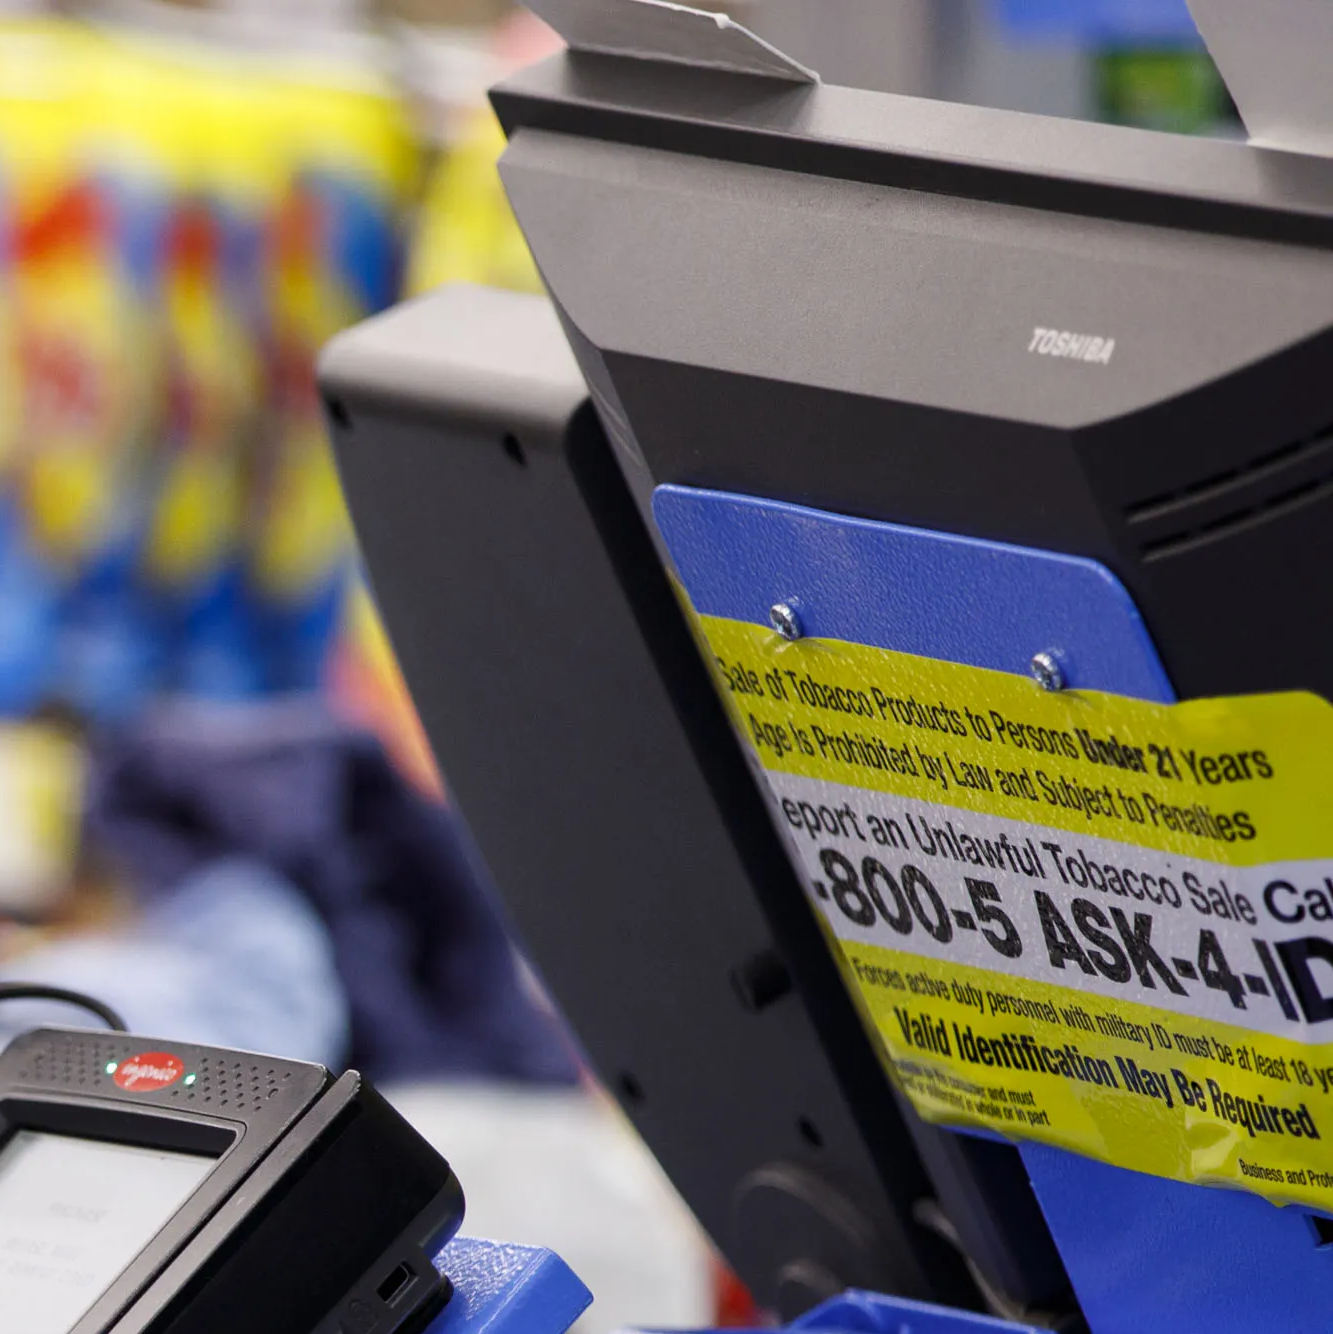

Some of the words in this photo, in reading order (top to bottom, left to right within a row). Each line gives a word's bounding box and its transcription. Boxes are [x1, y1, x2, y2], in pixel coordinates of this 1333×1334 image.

[1027, 326, 1116, 365] TOSHIBA
[717, 656, 764, 697] Sale
[765, 667, 790, 703] of
[784, 670, 874, 719] Tobacco
[871, 686, 967, 737] Products
[965, 706, 992, 742] to
[988, 710, 1079, 760] Persons
[1074, 728, 1149, 775] Under
[1148, 743, 1183, 782] 21
[1180, 748, 1274, 786] Years
[748, 712, 792, 758] Age
[788, 721, 815, 756] Is
[810, 724, 920, 777] Prohibited
[915, 745, 948, 790] by
[944, 752, 994, 792] Law
[995, 767, 1038, 801] and
[1035, 770, 1121, 820] Subject
[1117, 788, 1145, 825] to
[1142, 792, 1257, 843] Penalties
[781, 796, 866, 842] eport
[867, 814, 909, 850] an
[905, 812, 1047, 880] Unlawful
[1040, 840, 1182, 909] Tobacco
[1182, 871, 1258, 926] Sale
[851, 956, 906, 992] Forces
[904, 972, 951, 1001] active
[950, 978, 985, 1015] duty
[985, 989, 1061, 1025] personnel
[1058, 1004, 1096, 1033] with
[1094, 1013, 1155, 1051] military
[1150, 1022, 1173, 1050] ID
[1172, 1032, 1216, 1061] must
[1212, 1037, 1235, 1066] be
[1235, 1045, 1253, 1072] at
[1252, 1047, 1291, 1083] least
[1290, 1060, 1314, 1087] 18
[1033, 889, 1333, 1025] ASK-4-ID
[893, 1005, 953, 1058] Valid
[952, 1022, 1120, 1090] Identification
[1114, 1055, 1175, 1109] May
[1170, 1067, 1208, 1113] Be
[1205, 1077, 1321, 1141] Required
[1003, 1107, 1015, 1120] or
[1015, 1106, 1027, 1122] in
[1025, 1109, 1052, 1127] part
[1008, 1090, 1037, 1107] must
[1239, 1158, 1284, 1184] Business
[1286, 1169, 1307, 1186] and
